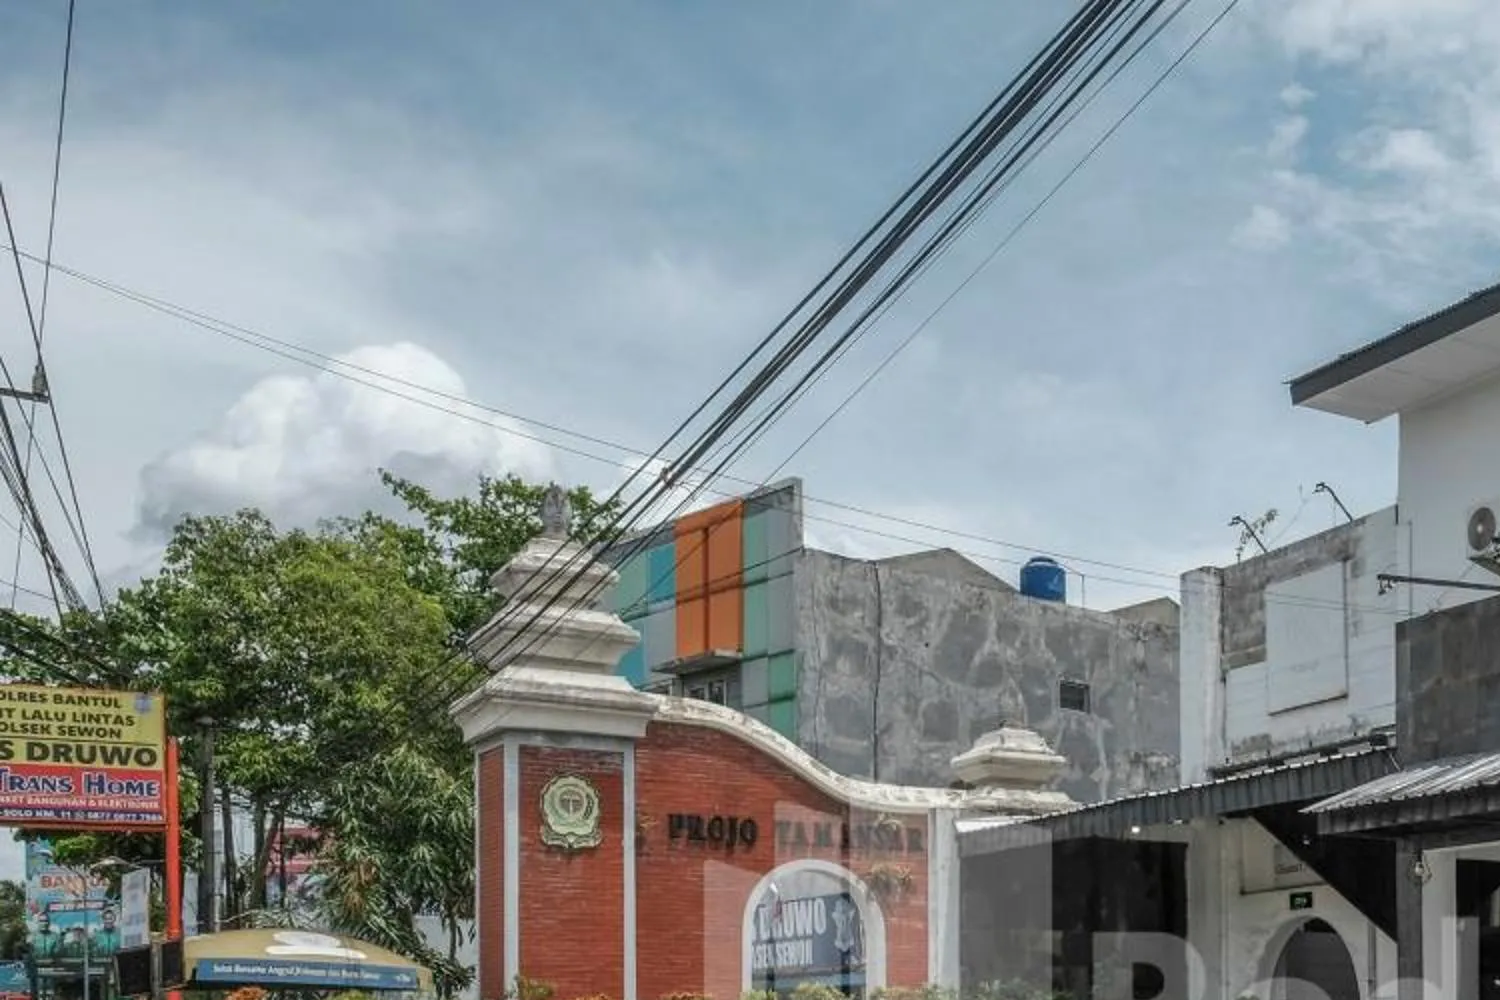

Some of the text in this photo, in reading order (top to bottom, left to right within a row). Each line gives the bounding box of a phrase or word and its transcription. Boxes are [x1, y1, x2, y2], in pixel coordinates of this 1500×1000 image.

[53, 694, 122, 709] BANTUL
[21, 708, 66, 722] LALU
[72, 710, 135, 727] LINTAS
[57, 725, 122, 739] SEWON
[26, 741, 157, 766] DRUWO
